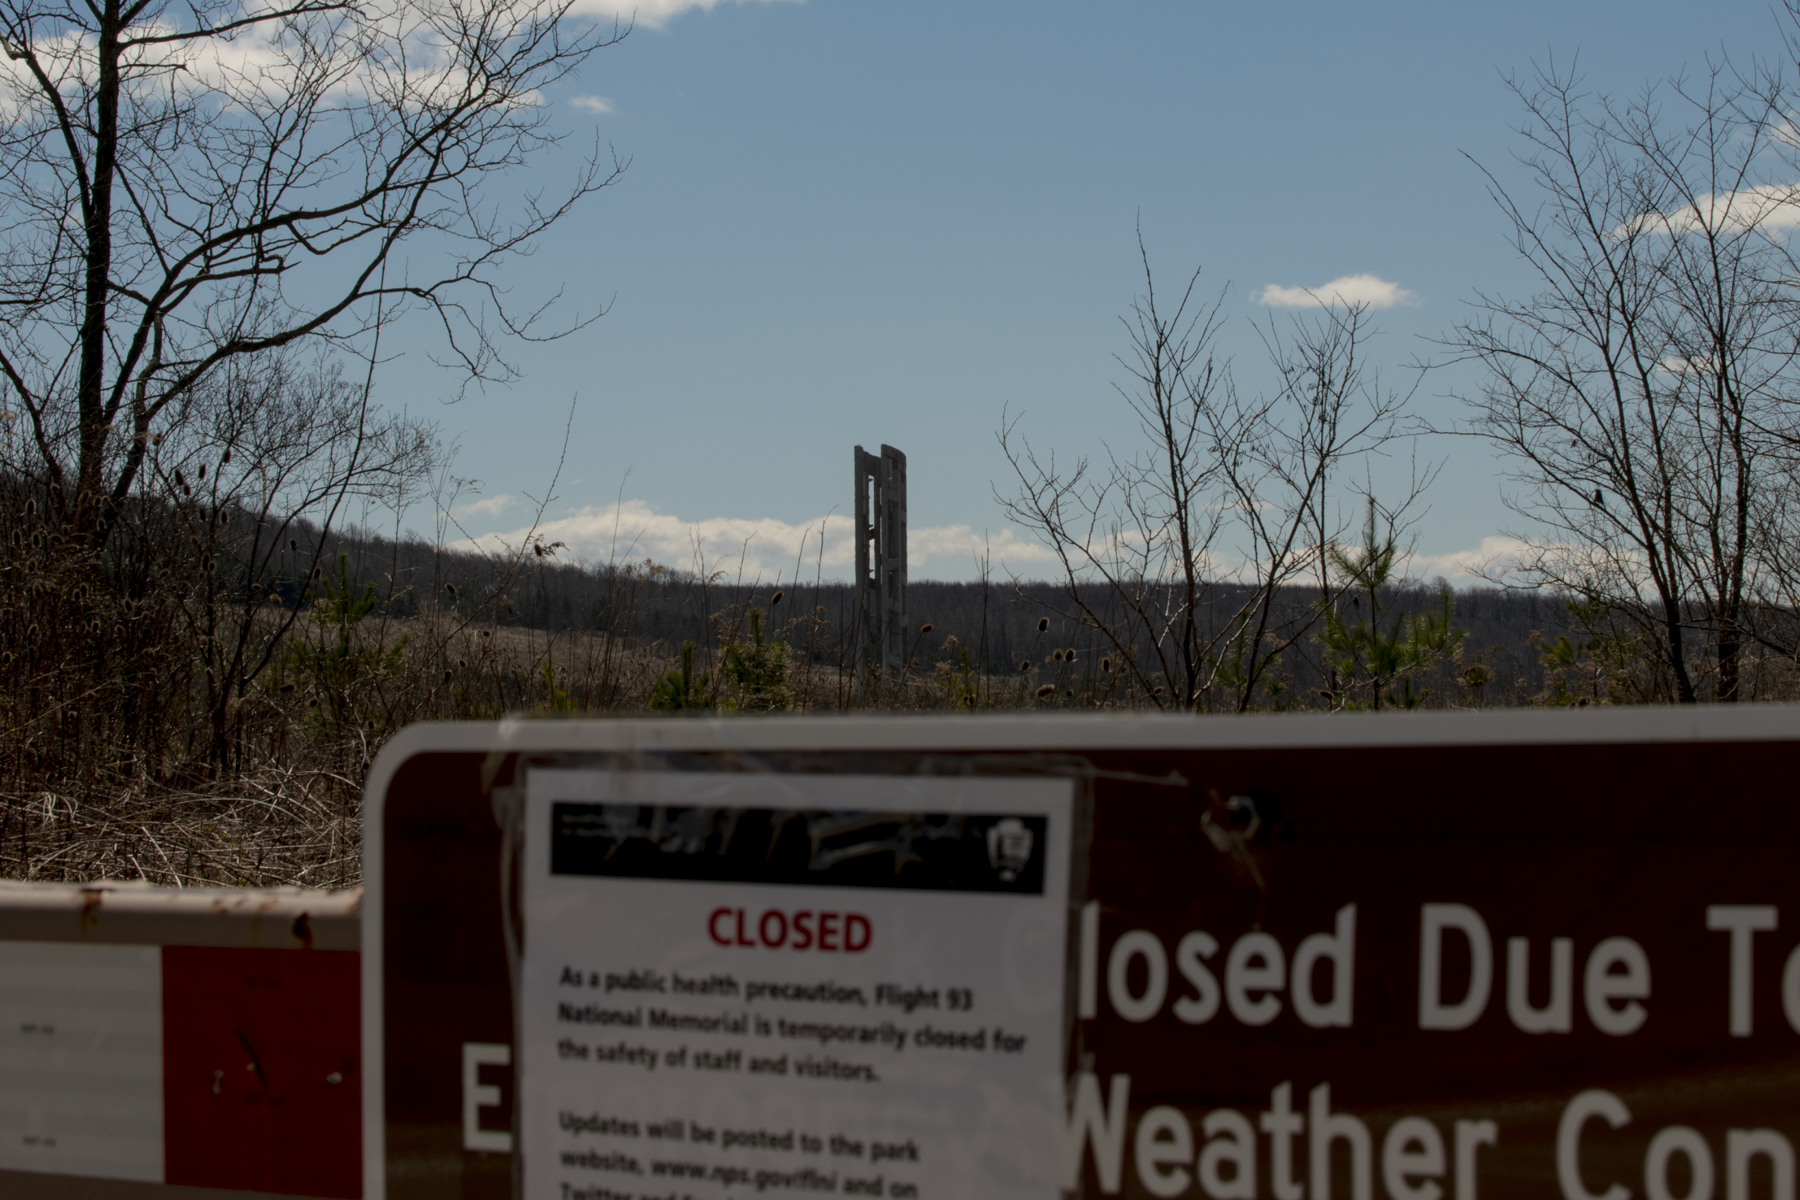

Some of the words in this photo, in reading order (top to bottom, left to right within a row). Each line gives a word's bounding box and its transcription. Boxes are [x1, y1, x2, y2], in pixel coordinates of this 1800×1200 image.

[708, 908, 873, 953] CLOSED
[559, 966, 583, 988] As
[588, 971, 600, 989] a
[604, 968, 666, 994] public
[672, 970, 739, 996] health
[745, 979, 868, 1008] precaution,
[875, 982, 939, 1013] Flight
[946, 987, 973, 1011] 93
[1077, 899, 1356, 1027] losed
[1418, 903, 1652, 1037] Due
[557, 1001, 643, 1028] National
[648, 1007, 749, 1035] Memorial
[754, 1013, 772, 1037] is
[777, 1016, 907, 1050] temporarily
[914, 1023, 987, 1051] closed
[992, 1026, 1028, 1054] for
[557, 1037, 590, 1061] the
[596, 1039, 659, 1072] safety
[664, 1043, 687, 1067] of
[692, 1047, 743, 1072] staff
[748, 1052, 788, 1075] and
[795, 1054, 880, 1082] visitors.
[559, 1110, 640, 1138] Updates
[646, 1117, 685, 1141] will
[690, 1119, 716, 1144] be
[722, 1128, 794, 1151] posted
[799, 1132, 823, 1154] to
[829, 1132, 864, 1158] the
[870, 1137, 920, 1164] park
[1060, 1073, 1499, 1200] Weather
[559, 1147, 644, 1177] website,
[843, 1174, 884, 1198] and
[889, 1181, 920, 1200] on
